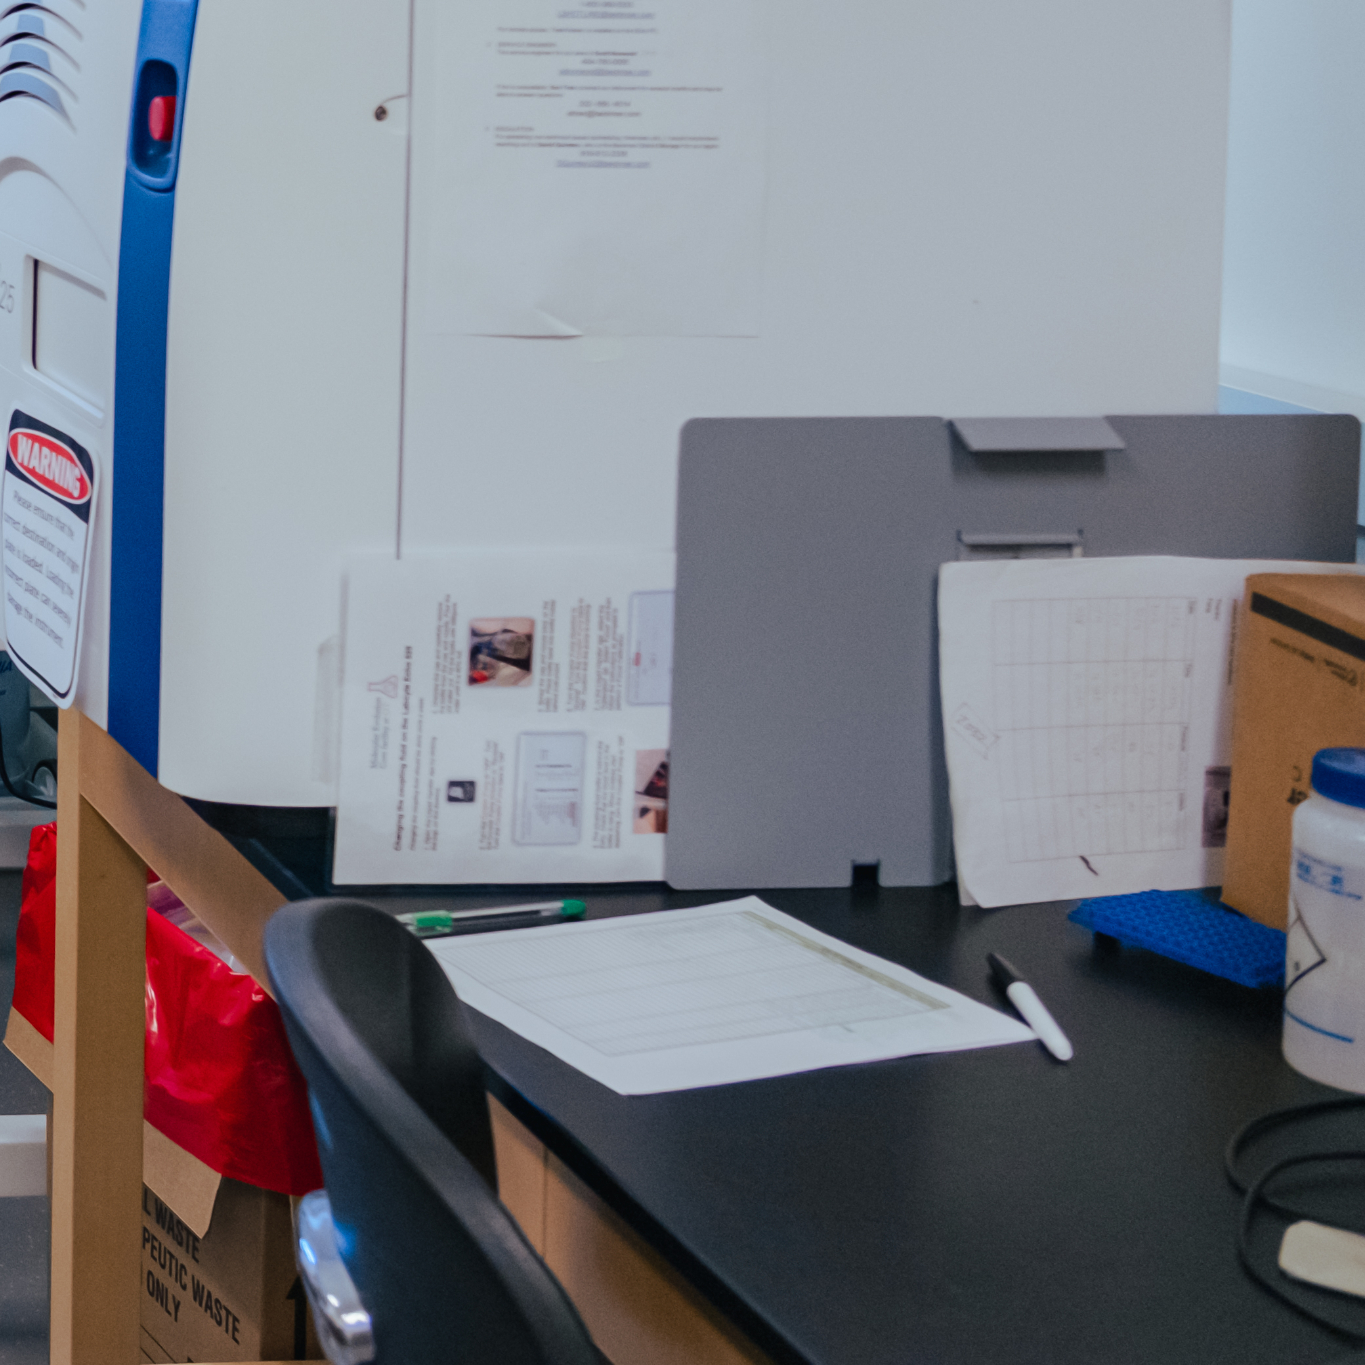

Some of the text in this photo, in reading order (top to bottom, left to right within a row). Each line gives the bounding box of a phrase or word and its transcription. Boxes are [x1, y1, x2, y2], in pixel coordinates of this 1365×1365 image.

[17, 433, 81, 498] WARNING
[154, 1197, 200, 1265] WASTE
[146, 1269, 181, 1323] ONLY
[191, 1274, 241, 1345] WASTE
